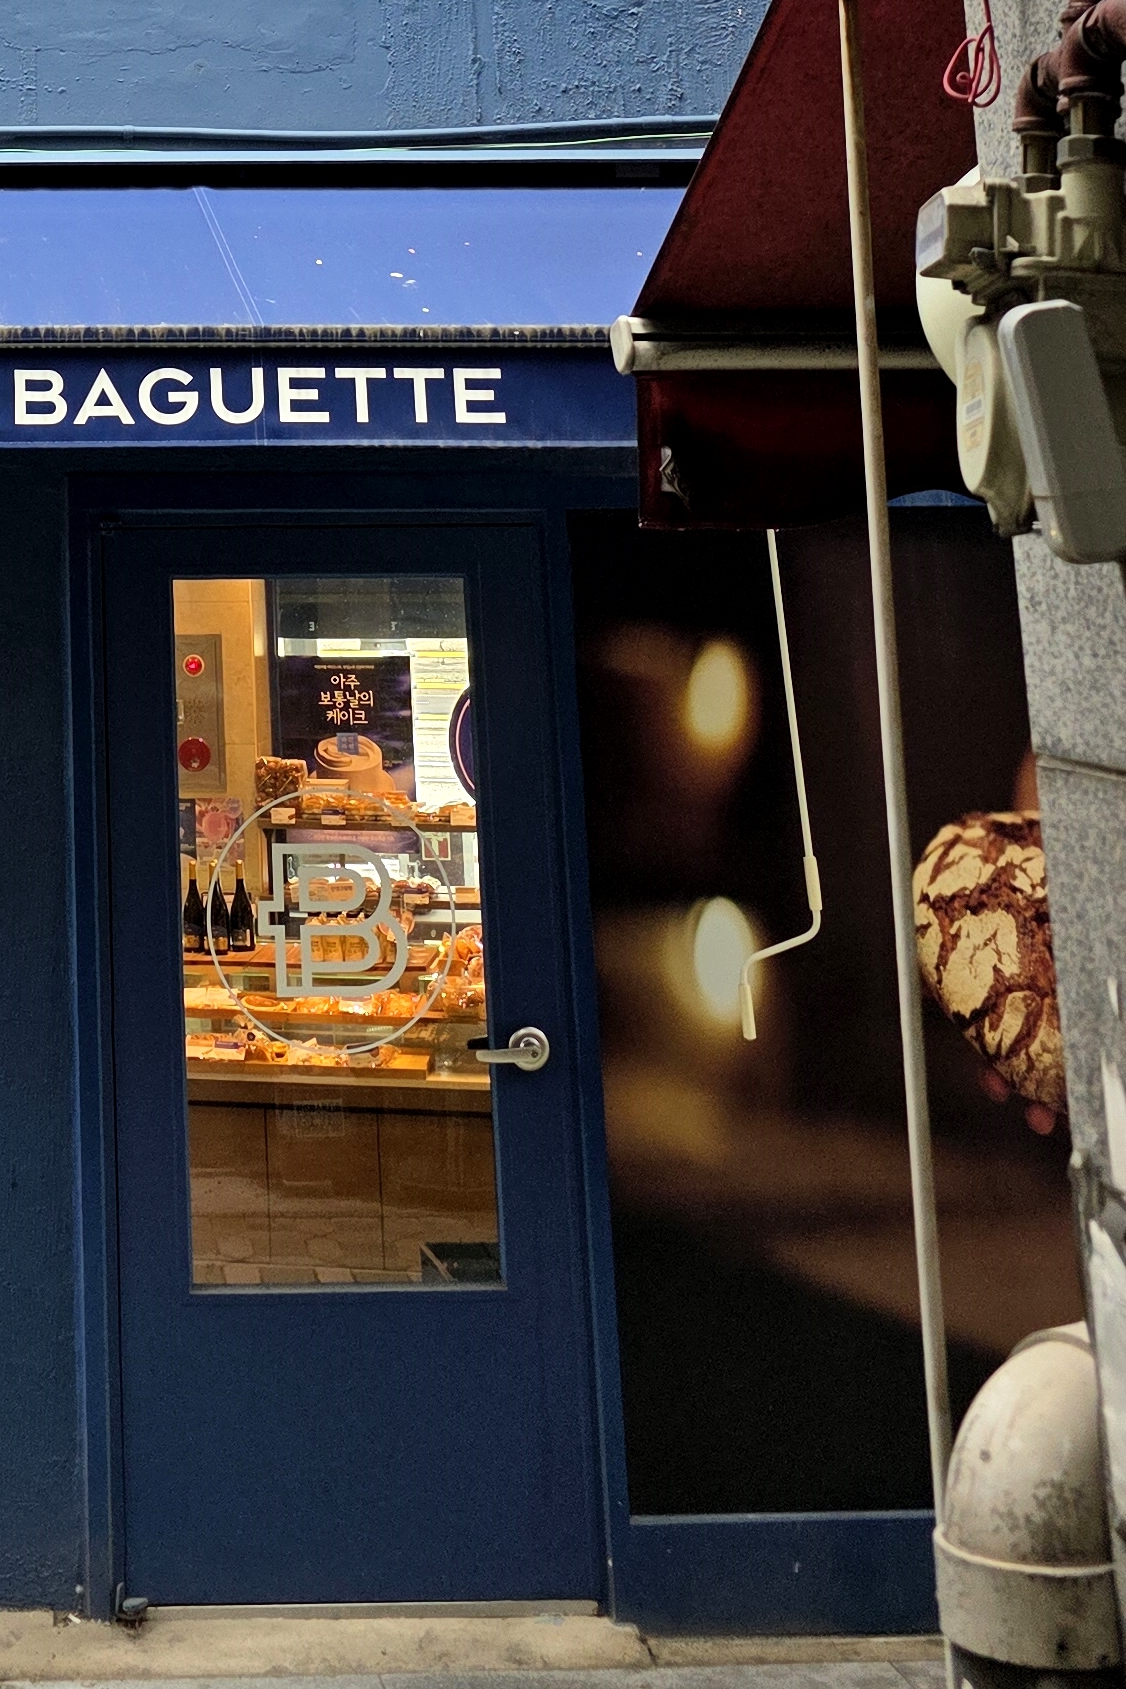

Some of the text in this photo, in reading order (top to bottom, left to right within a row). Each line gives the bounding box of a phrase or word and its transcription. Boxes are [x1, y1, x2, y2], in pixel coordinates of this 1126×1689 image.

[12, 367, 507, 426] BAGUETTE
[330, 673, 361, 691] 아주
[317, 689, 375, 709] 보통날의
[325, 708, 369, 726] 케이크
